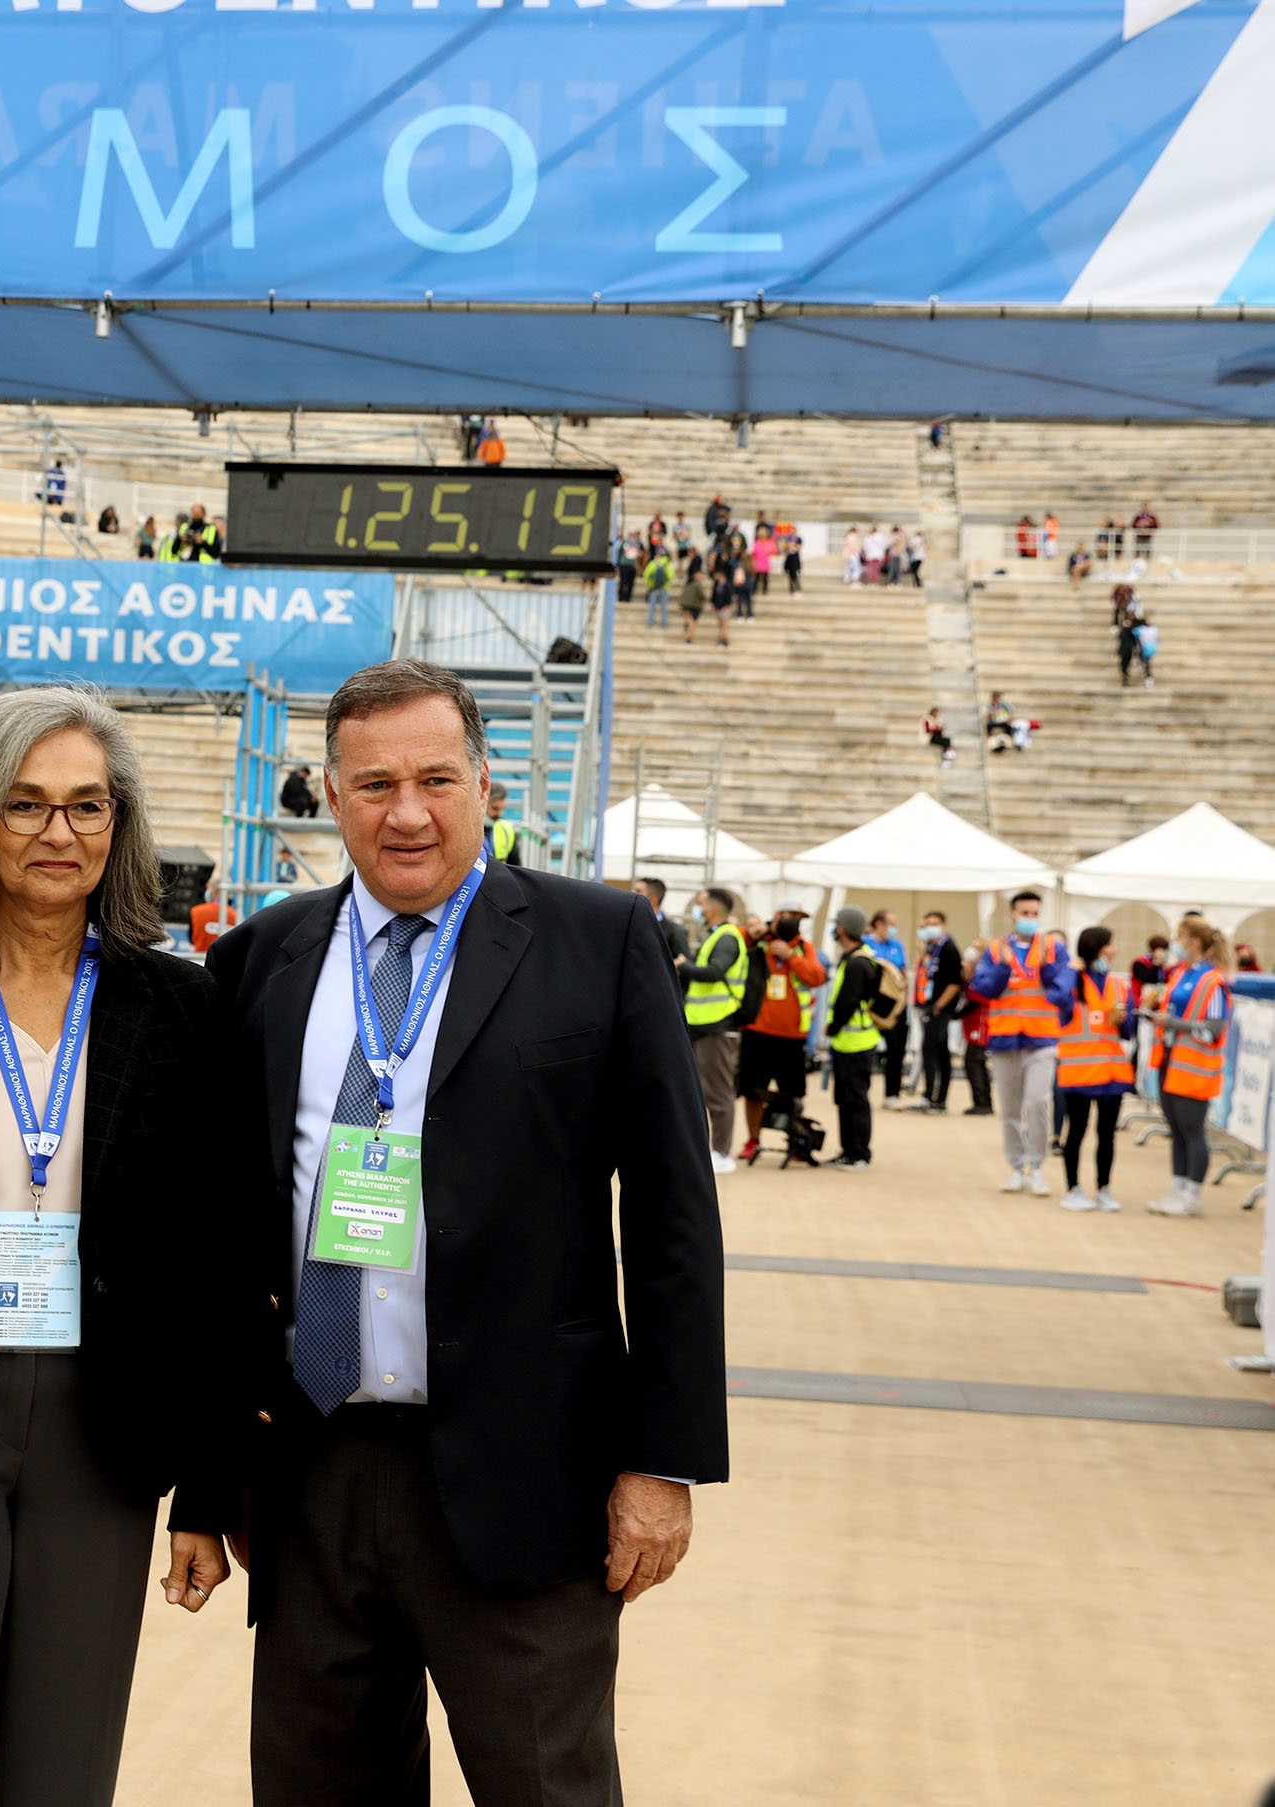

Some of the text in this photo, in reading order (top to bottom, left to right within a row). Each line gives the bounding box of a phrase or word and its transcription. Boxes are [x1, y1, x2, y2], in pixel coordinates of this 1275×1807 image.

[118, 582, 356, 624] ΑΘΗΝΑΣ
[399, 997, 426, 1053] ΜΑΡΑΘΩΝΙΟΣ
[438, 904, 463, 952] ΑΥΘΕΝΤΙΚΟΣ
[457, 886, 470, 902] 2021
[48, 1073, 68, 1129] ΜΑΡΑΘΩΝΙΟΣ
[71, 978, 90, 1027] ΑΥΘΕΝΤΙΚΟΣ
[336, 1169, 410, 1185] ATHENS MARATHON
[343, 1178, 401, 1193] THE AUTHENTIC
